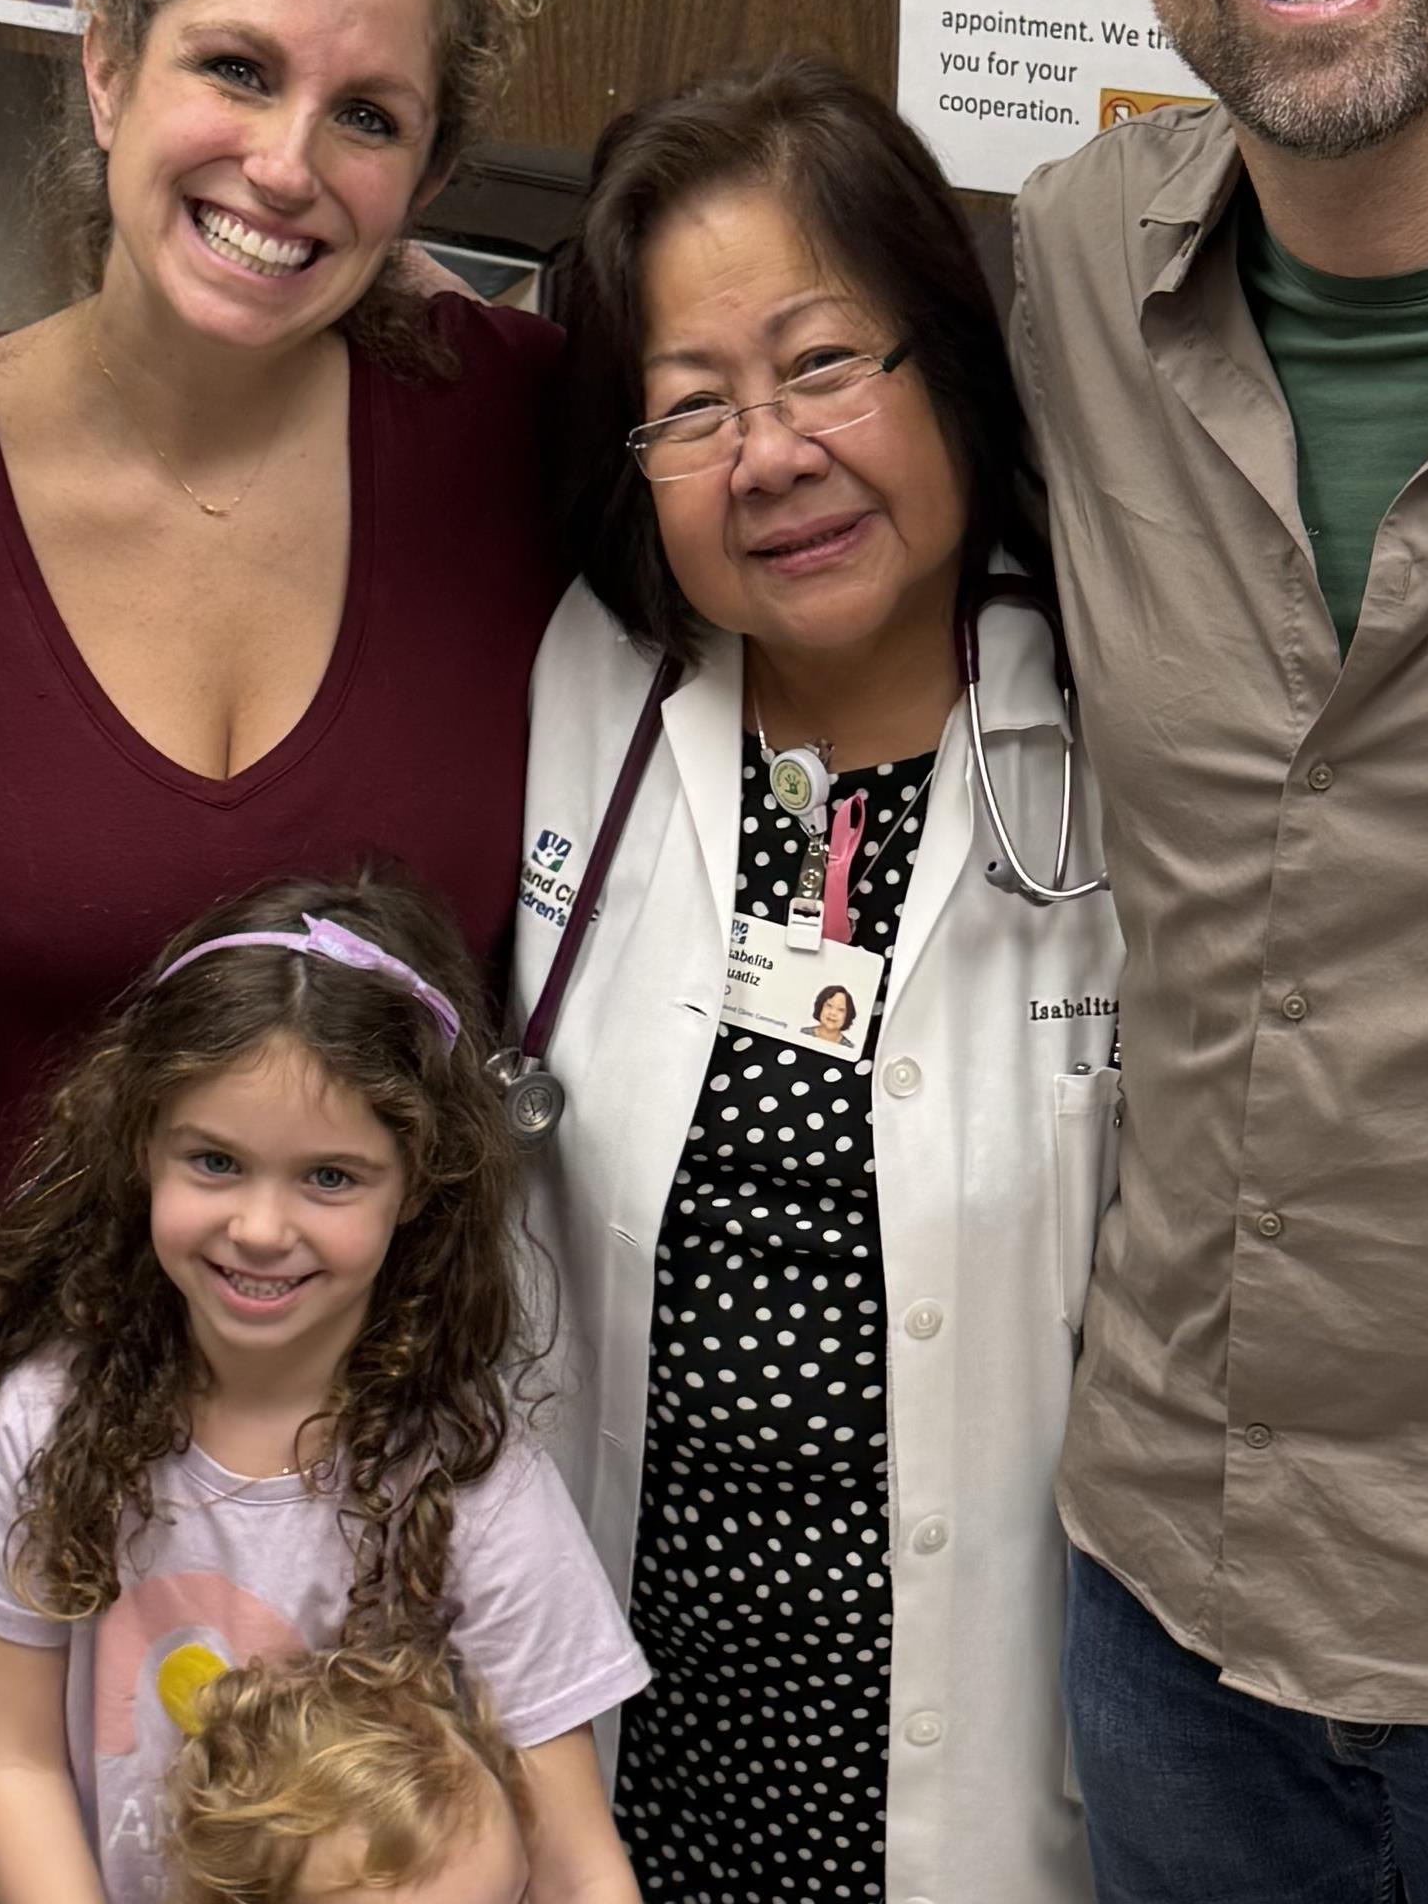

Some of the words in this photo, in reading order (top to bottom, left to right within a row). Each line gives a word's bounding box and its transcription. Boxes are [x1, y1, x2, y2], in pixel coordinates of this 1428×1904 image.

[942, 10, 1094, 43] appointment.
[1101, 21, 1139, 46] We
[1147, 27, 1170, 50] th
[940, 52, 980, 75] you
[987, 51, 1020, 76] for
[1025, 61, 1078, 84] your
[939, 93, 1080, 125] cooperation.
[727, 967, 761, 986] uadiz
